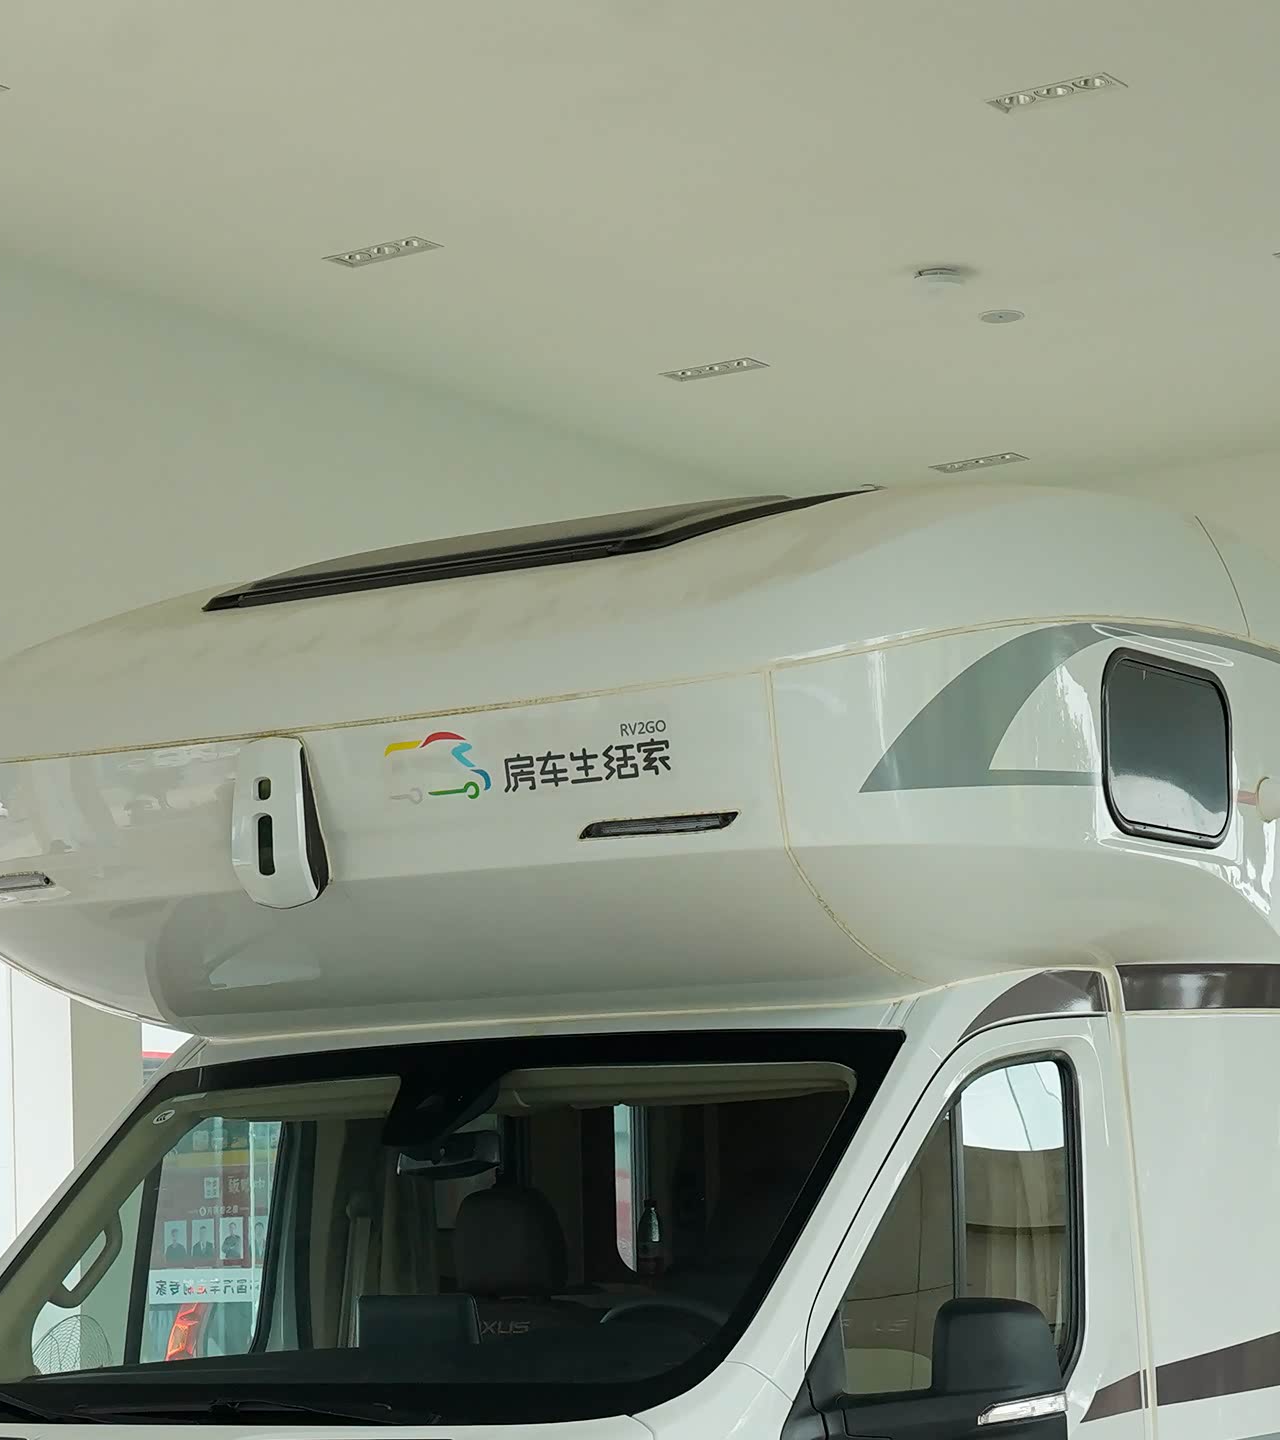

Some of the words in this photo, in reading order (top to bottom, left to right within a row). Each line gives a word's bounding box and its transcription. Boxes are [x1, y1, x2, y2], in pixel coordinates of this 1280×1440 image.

[618, 719, 667, 738] RV2GO
[503, 737, 673, 794] 房车生活家
[480, 1320, 532, 1335] XUS
